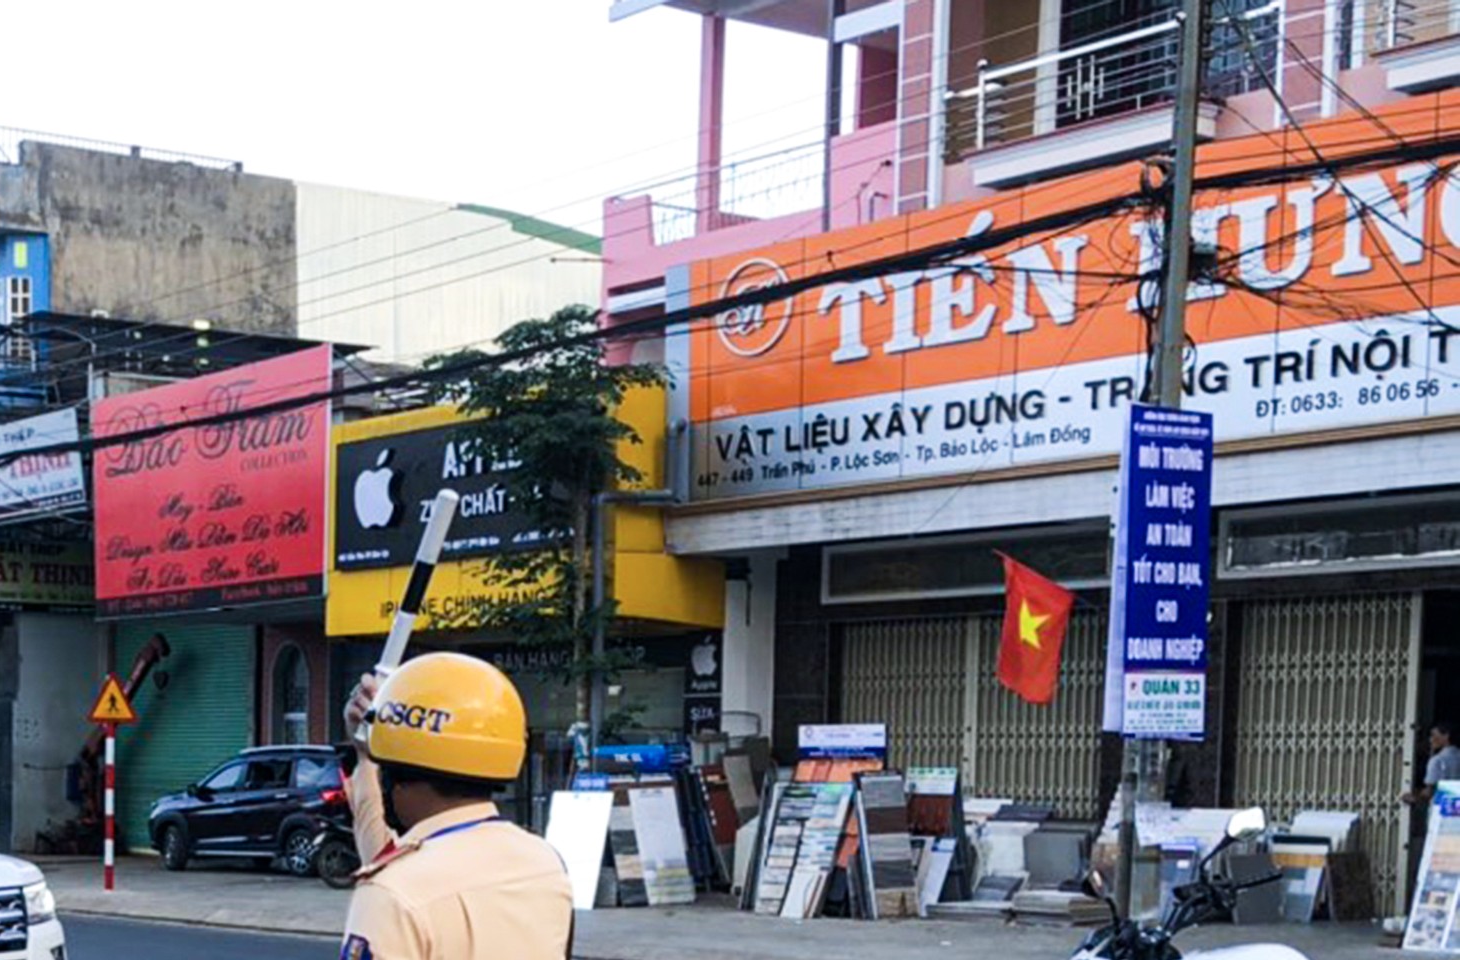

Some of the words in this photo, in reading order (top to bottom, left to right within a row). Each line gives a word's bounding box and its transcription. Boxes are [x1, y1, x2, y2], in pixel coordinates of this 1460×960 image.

[716, 425, 775, 466] VẬT
[784, 413, 849, 454] LIỆU
[861, 402, 932, 442] XÂY
[944, 389, 1047, 434] DỰNG
[1085, 360, 1229, 411] TRNG
[1244, 339, 1322, 389] TRÍ
[1330, 329, 1411, 381] NỘI
[1256, 400, 1287, 418] ĐT:
[1290, 392, 1344, 413] 0633:
[1358, 385, 1381, 405] 86
[1386, 382, 1409, 402] 06
[1415, 378, 1441, 399] 56
[698, 471, 719, 487] 447
[731, 467, 754, 483] 449
[831, 456, 843, 471] P.
[845, 450, 869, 471] Lộc
[872, 448, 900, 466] Sơn
[916, 445, 937, 463] Tp.
[941, 439, 969, 458] Bảo
[460, 482, 507, 518] CHẤT
[1185, 679, 1201, 695] 33
[377, 701, 450, 733] CSGT
